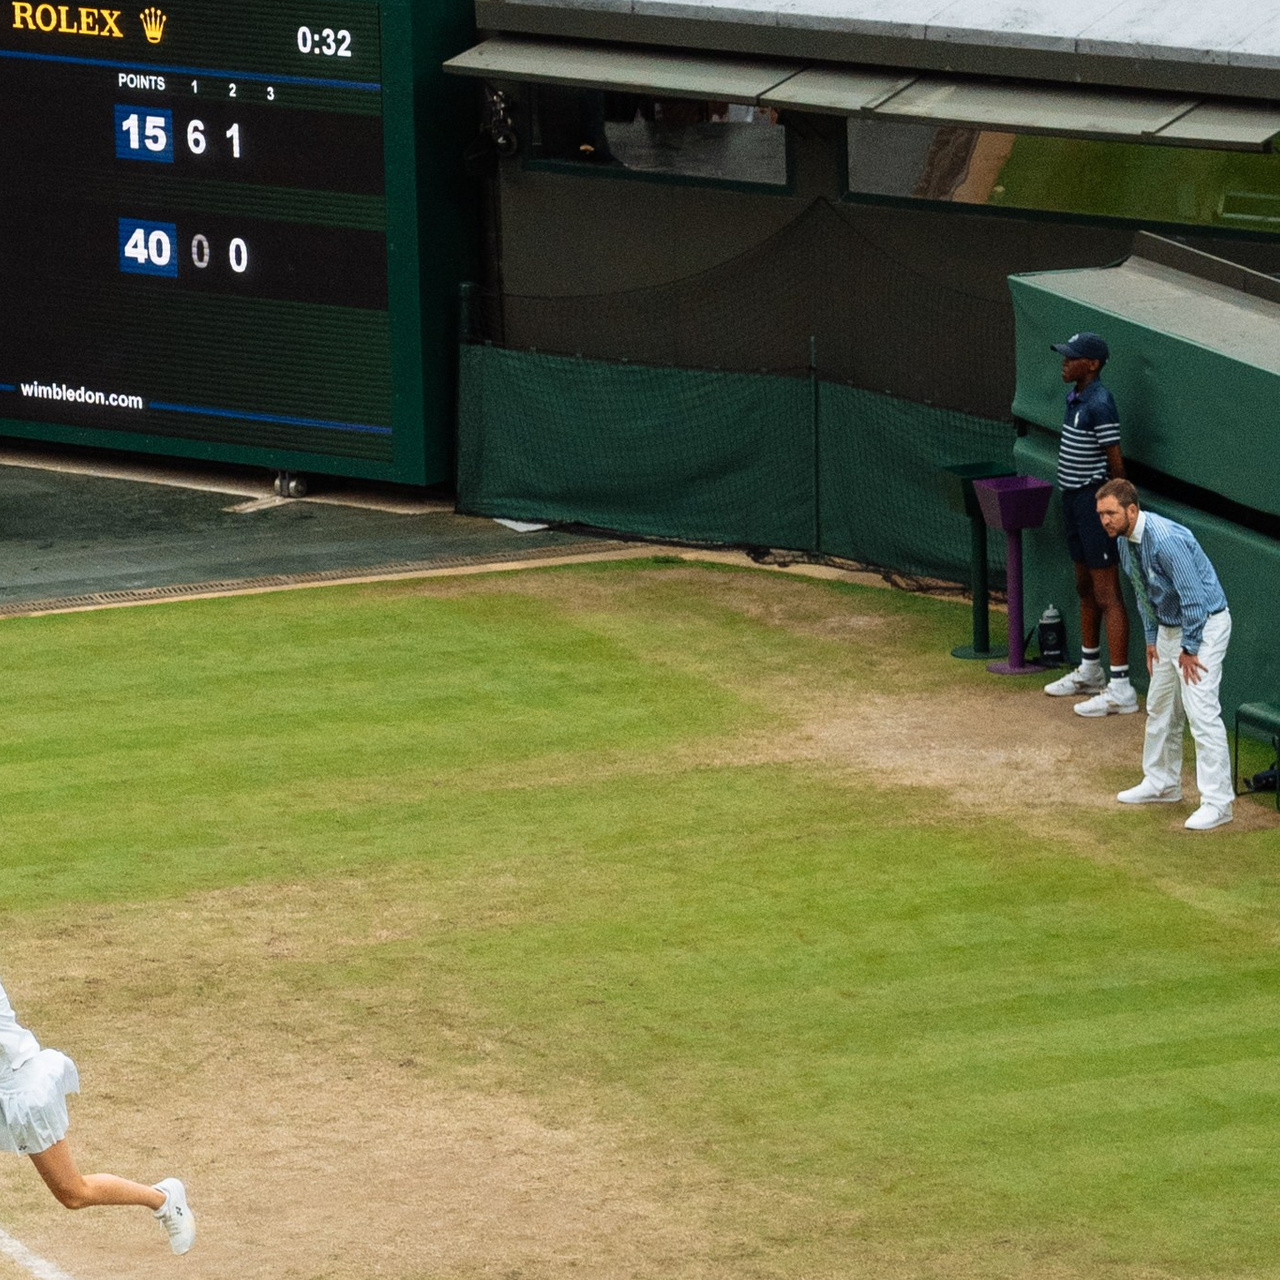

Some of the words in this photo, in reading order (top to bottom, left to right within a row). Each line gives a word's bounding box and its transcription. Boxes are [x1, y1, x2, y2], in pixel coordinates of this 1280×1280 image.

[12, 2, 123, 37] ROLEX
[297, 25, 352, 58] 0:32
[118, 72, 166, 91] POINTS
[191, 79, 198, 94] 1
[228, 82, 237, 98] 2
[266, 86, 275, 101] 3
[123, 114, 166, 151] 15
[187, 120, 206, 154] 6
[226, 124, 239, 157] 1
[125, 229, 170, 265] 40
[192, 234, 209, 268] 0
[229, 238, 247, 272] 0
[21, 381, 142, 409] wimbledon.com
